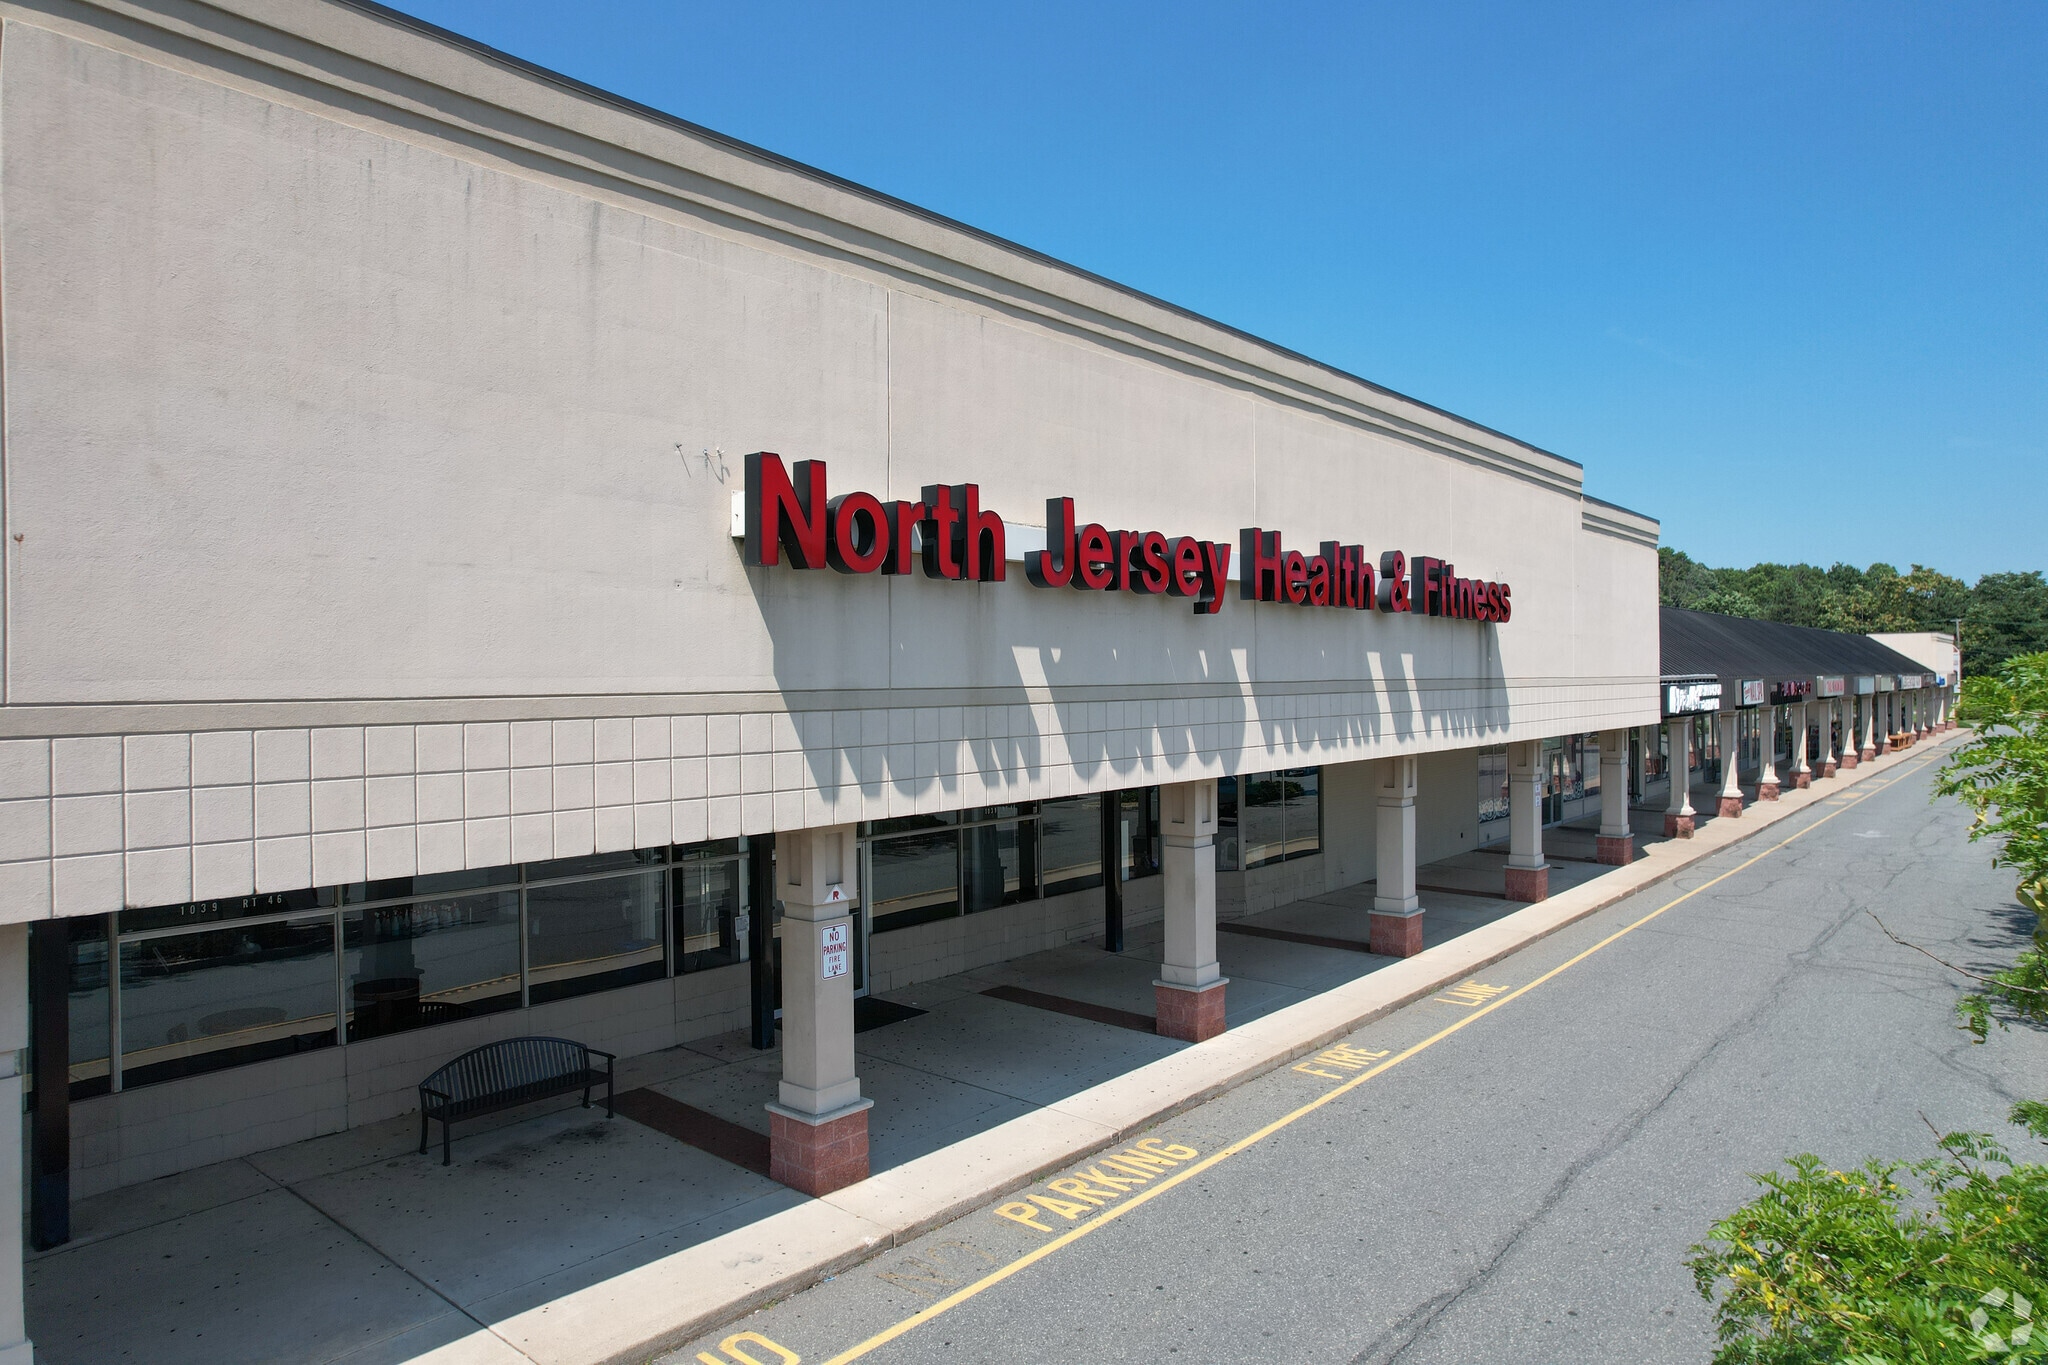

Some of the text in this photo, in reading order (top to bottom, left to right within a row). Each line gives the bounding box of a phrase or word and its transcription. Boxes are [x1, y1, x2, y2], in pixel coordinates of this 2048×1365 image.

[748, 451, 1511, 623] North Jersey Health & Fitness
[832, 890, 839, 900] R
[180, 894, 282, 915] 1039 RT 46
[829, 931, 839, 942] NO
[823, 942, 846, 955] PARKING
[829, 955, 840, 963] FIRE
[828, 964, 841, 972] LANE
[993, 1138, 1199, 1233] PARKING
[1291, 1043, 1391, 1080] FIRE
[1434, 979, 1510, 1007] LANE
